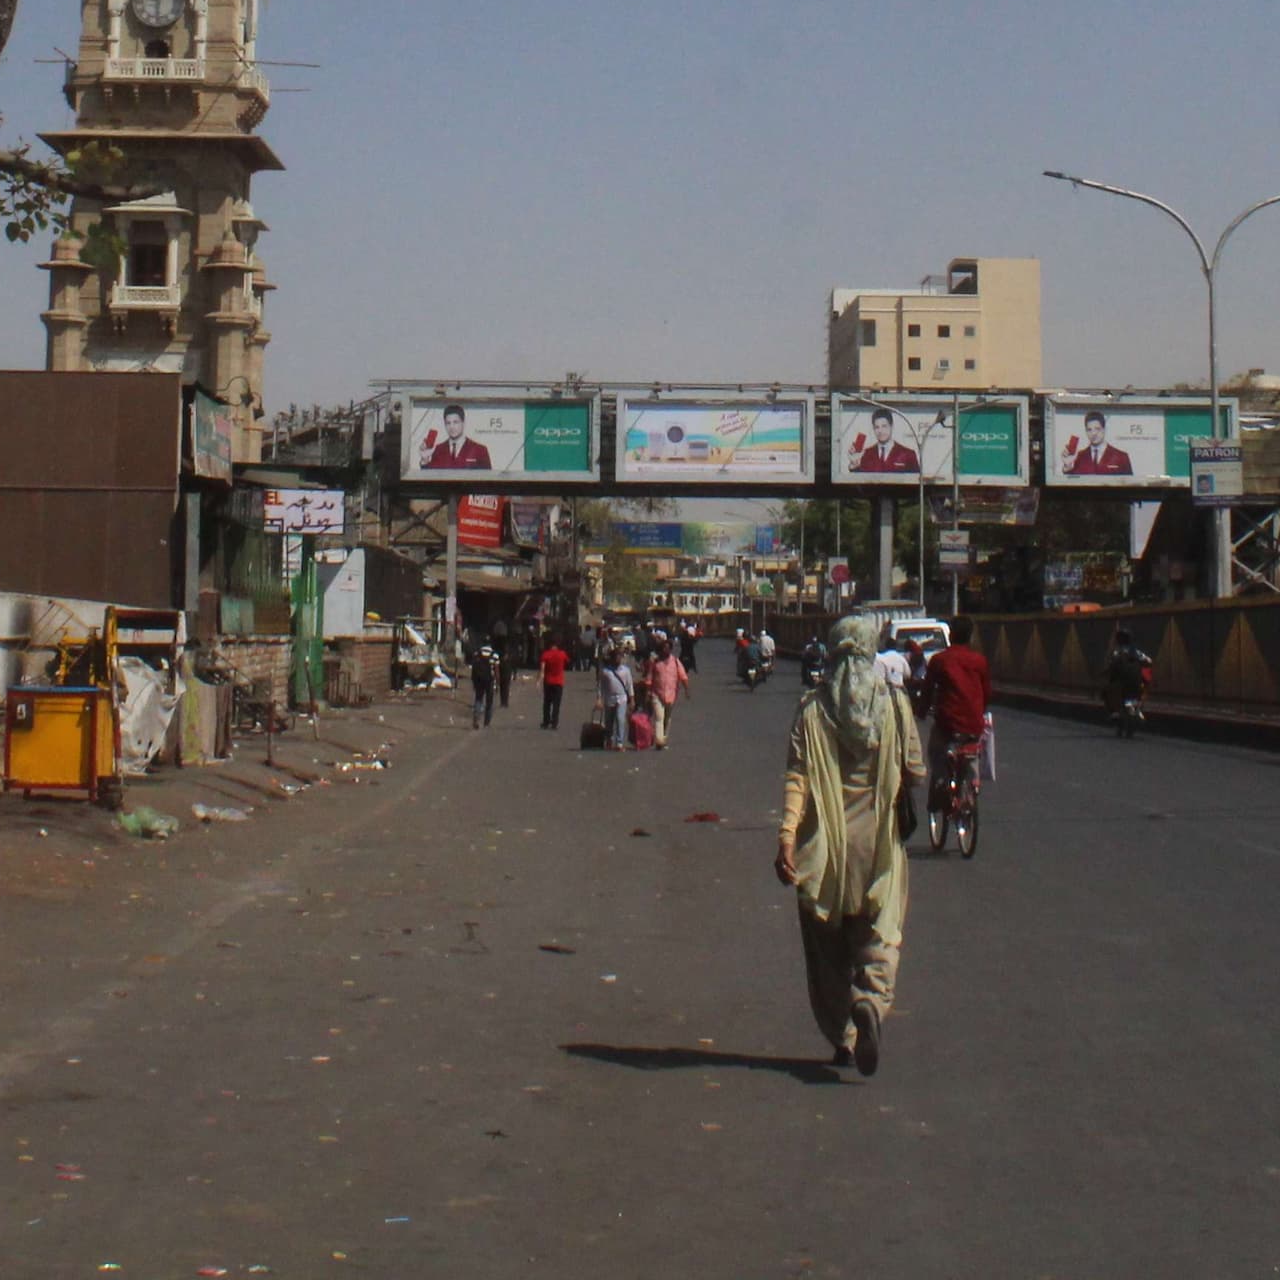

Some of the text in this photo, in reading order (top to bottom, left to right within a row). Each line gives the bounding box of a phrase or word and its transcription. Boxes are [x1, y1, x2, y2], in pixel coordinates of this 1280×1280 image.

[490, 417, 503, 428] F5
[534, 426, 582, 438] oppo
[1130, 424, 1143, 435] F5
[962, 432, 1009, 442] oppo
[1194, 449, 1240, 459] PATRON
